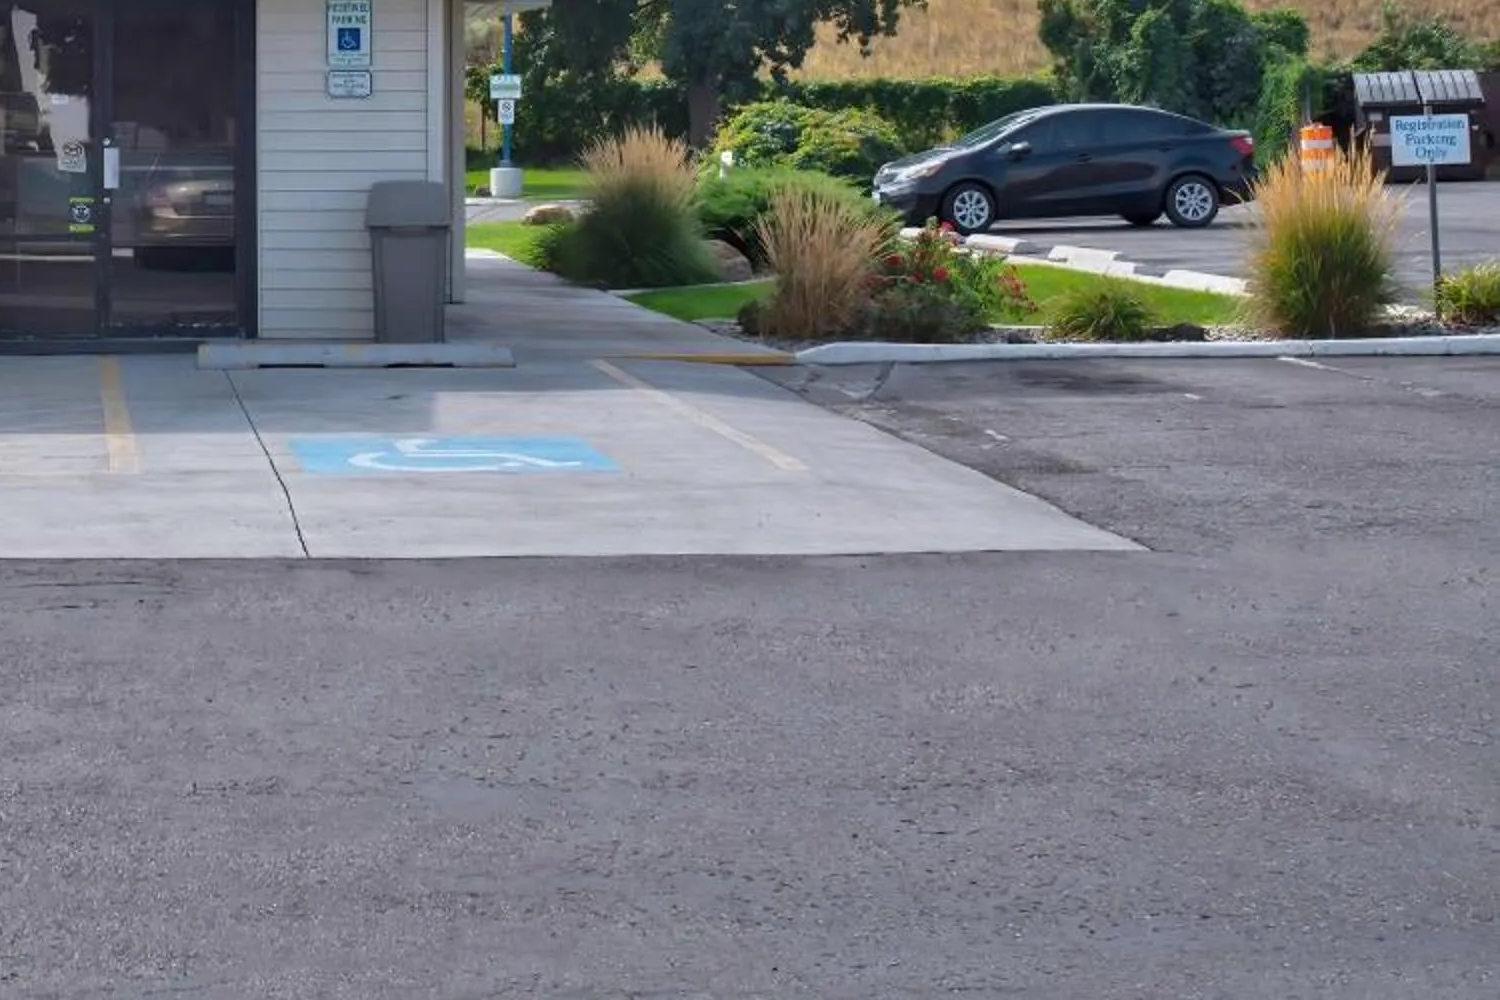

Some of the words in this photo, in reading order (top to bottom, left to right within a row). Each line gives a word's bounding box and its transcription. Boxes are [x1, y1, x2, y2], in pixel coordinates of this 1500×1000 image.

[1395, 119, 1465, 132] Registration
[1406, 133, 1457, 147] Parking
[1415, 147, 1447, 160] Only
